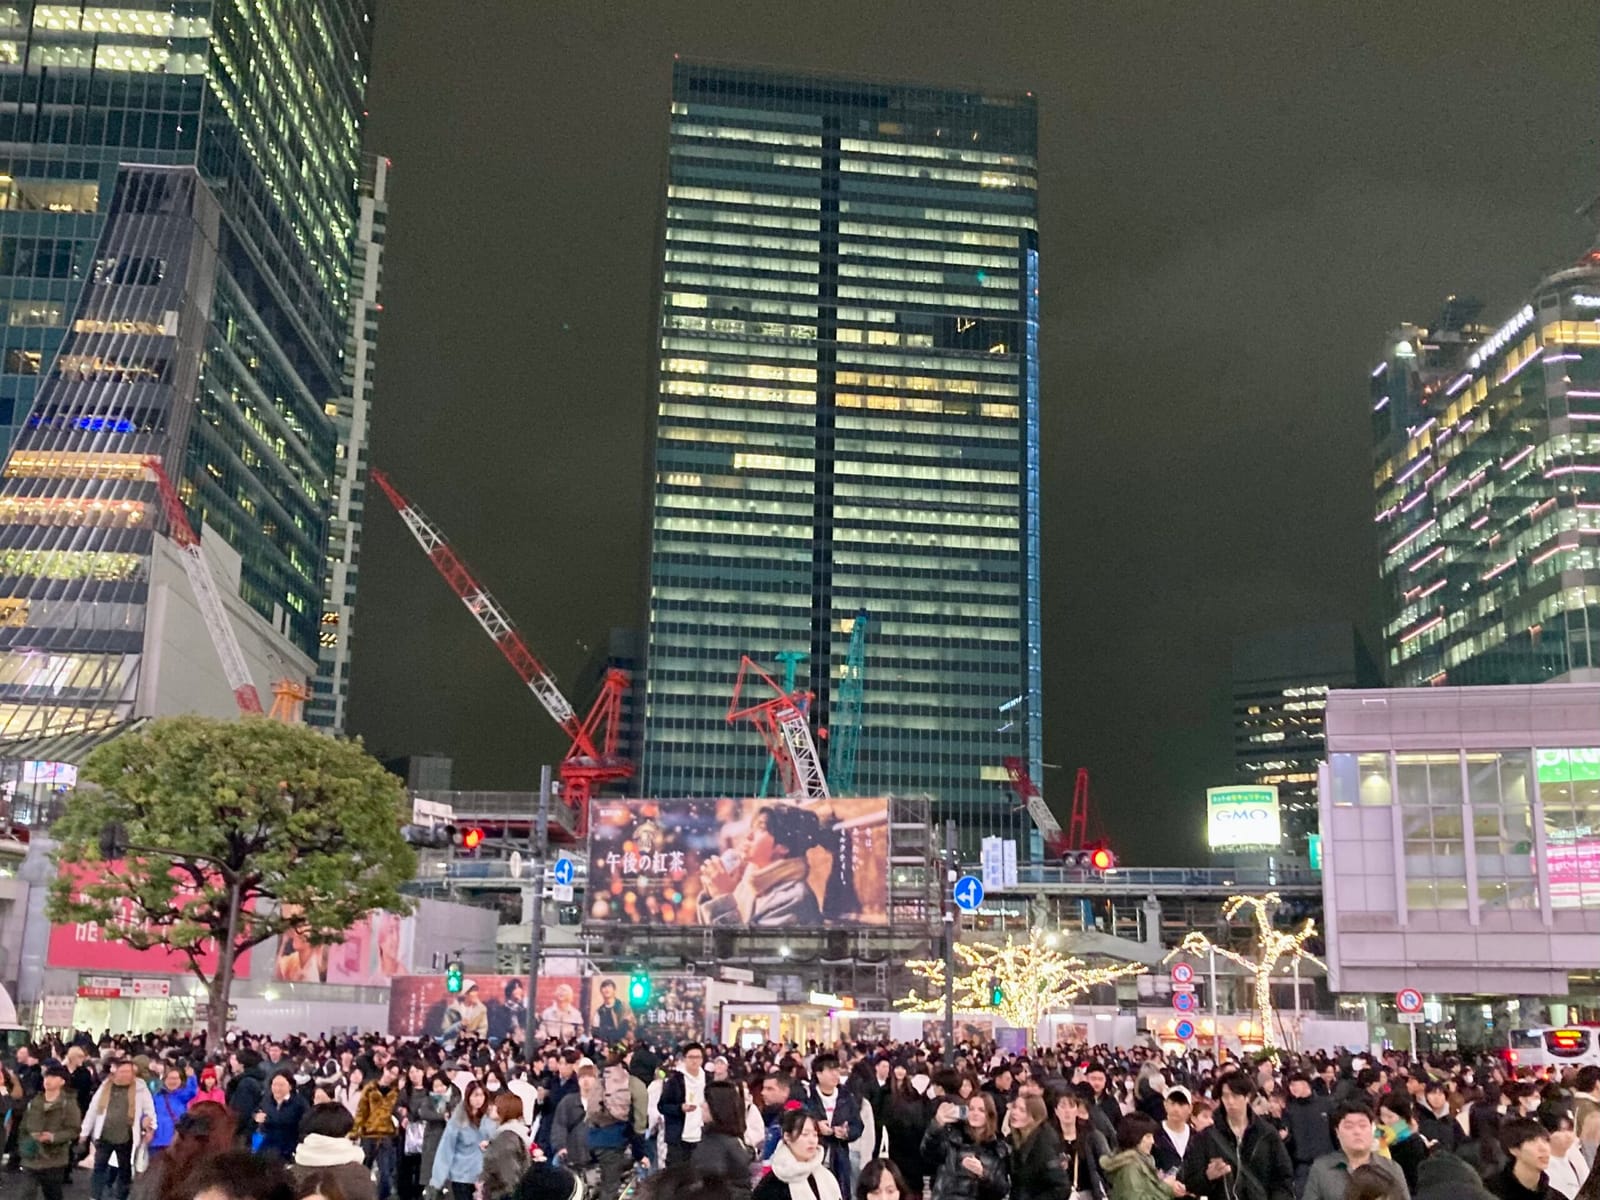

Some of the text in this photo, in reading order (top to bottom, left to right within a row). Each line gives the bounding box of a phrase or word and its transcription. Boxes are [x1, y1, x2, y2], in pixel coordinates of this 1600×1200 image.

[1215, 808, 1268, 822] GMO
[605, 850, 686, 875] 午後の紅茶
